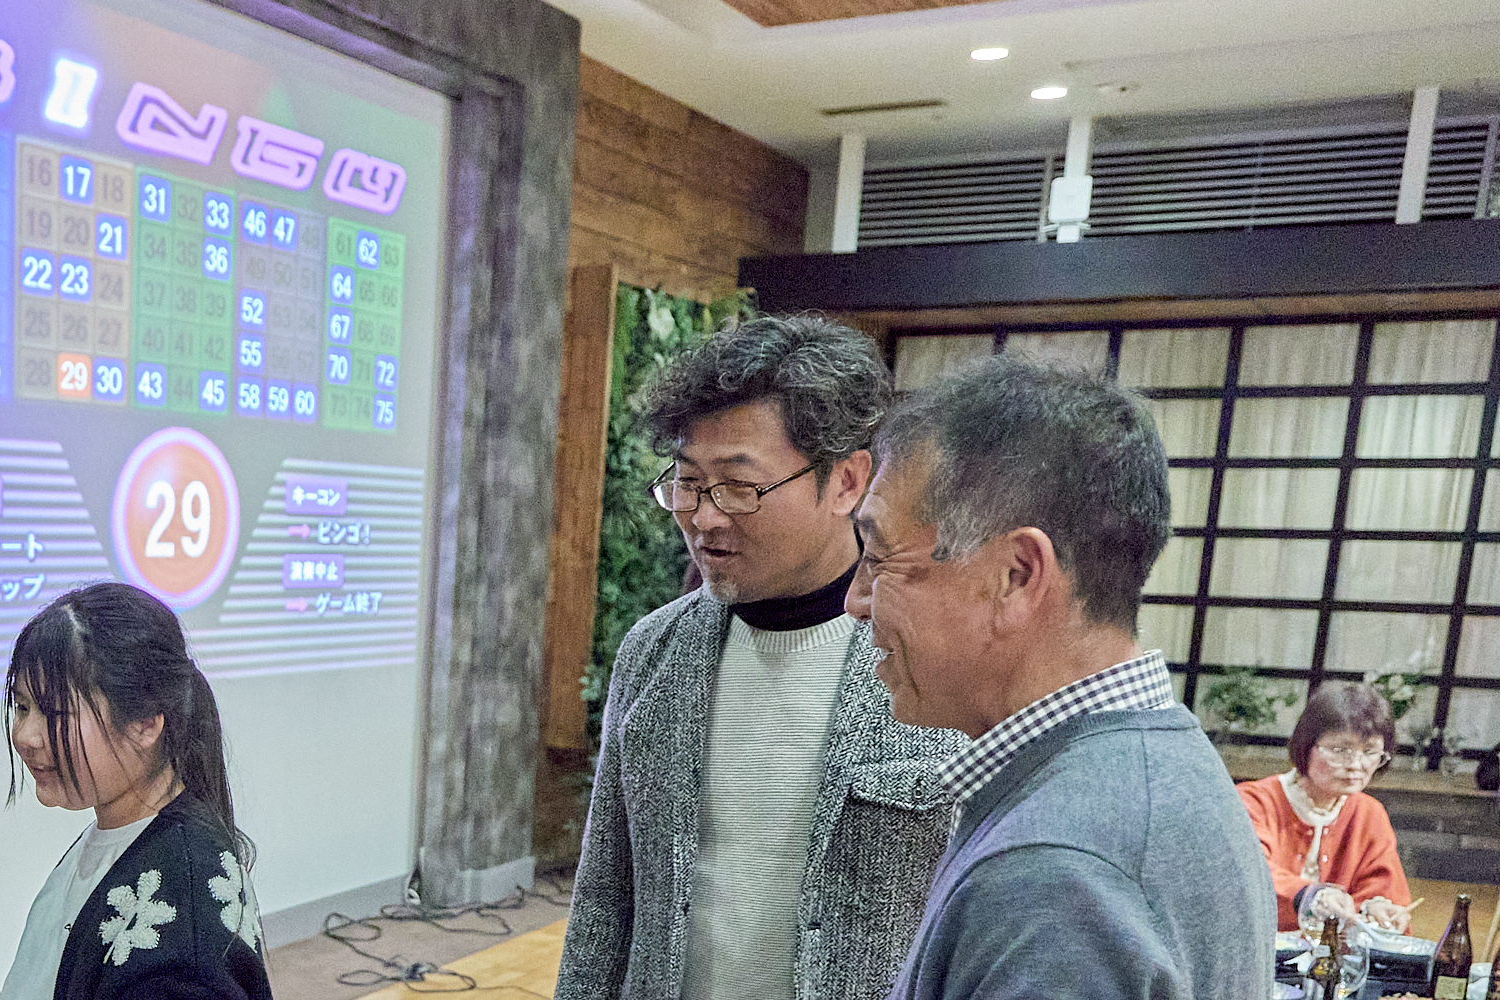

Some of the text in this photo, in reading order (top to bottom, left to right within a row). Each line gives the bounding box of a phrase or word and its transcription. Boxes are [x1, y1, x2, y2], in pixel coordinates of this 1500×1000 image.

[28, 156, 52, 186] 16
[64, 165, 91, 198] 17
[103, 173, 124, 203] 18
[144, 184, 166, 215] 31
[206, 199, 229, 230] 33
[244, 209, 266, 238] 46
[273, 216, 295, 245] 47
[358, 237, 377, 265] 62
[28, 207, 52, 239] 19
[63, 215, 90, 246] 20
[99, 222, 122, 254] 21
[205, 244, 228, 274] 36
[332, 272, 351, 300] 64
[23, 256, 52, 290] 22
[61, 263, 88, 295] 23
[100, 273, 124, 301] 24
[242, 296, 264, 325] 52
[330, 313, 350, 339] 67
[25, 307, 51, 339] 25
[63, 312, 89, 342] 26
[99, 318, 122, 346] 27
[241, 340, 262, 367] 55
[328, 353, 348, 380] 70
[377, 360, 395, 386] 72
[25, 358, 52, 387] 28
[61, 360, 88, 391] 29
[96, 365, 123, 394] 30
[138, 370, 162, 399] 43
[202, 378, 225, 406] 45
[239, 382, 260, 409] 58
[268, 386, 289, 412] 59
[294, 390, 315, 415] 60
[376, 399, 394, 425] 75
[145, 480, 211, 558] 29
[292, 485, 341, 507] キーコン
